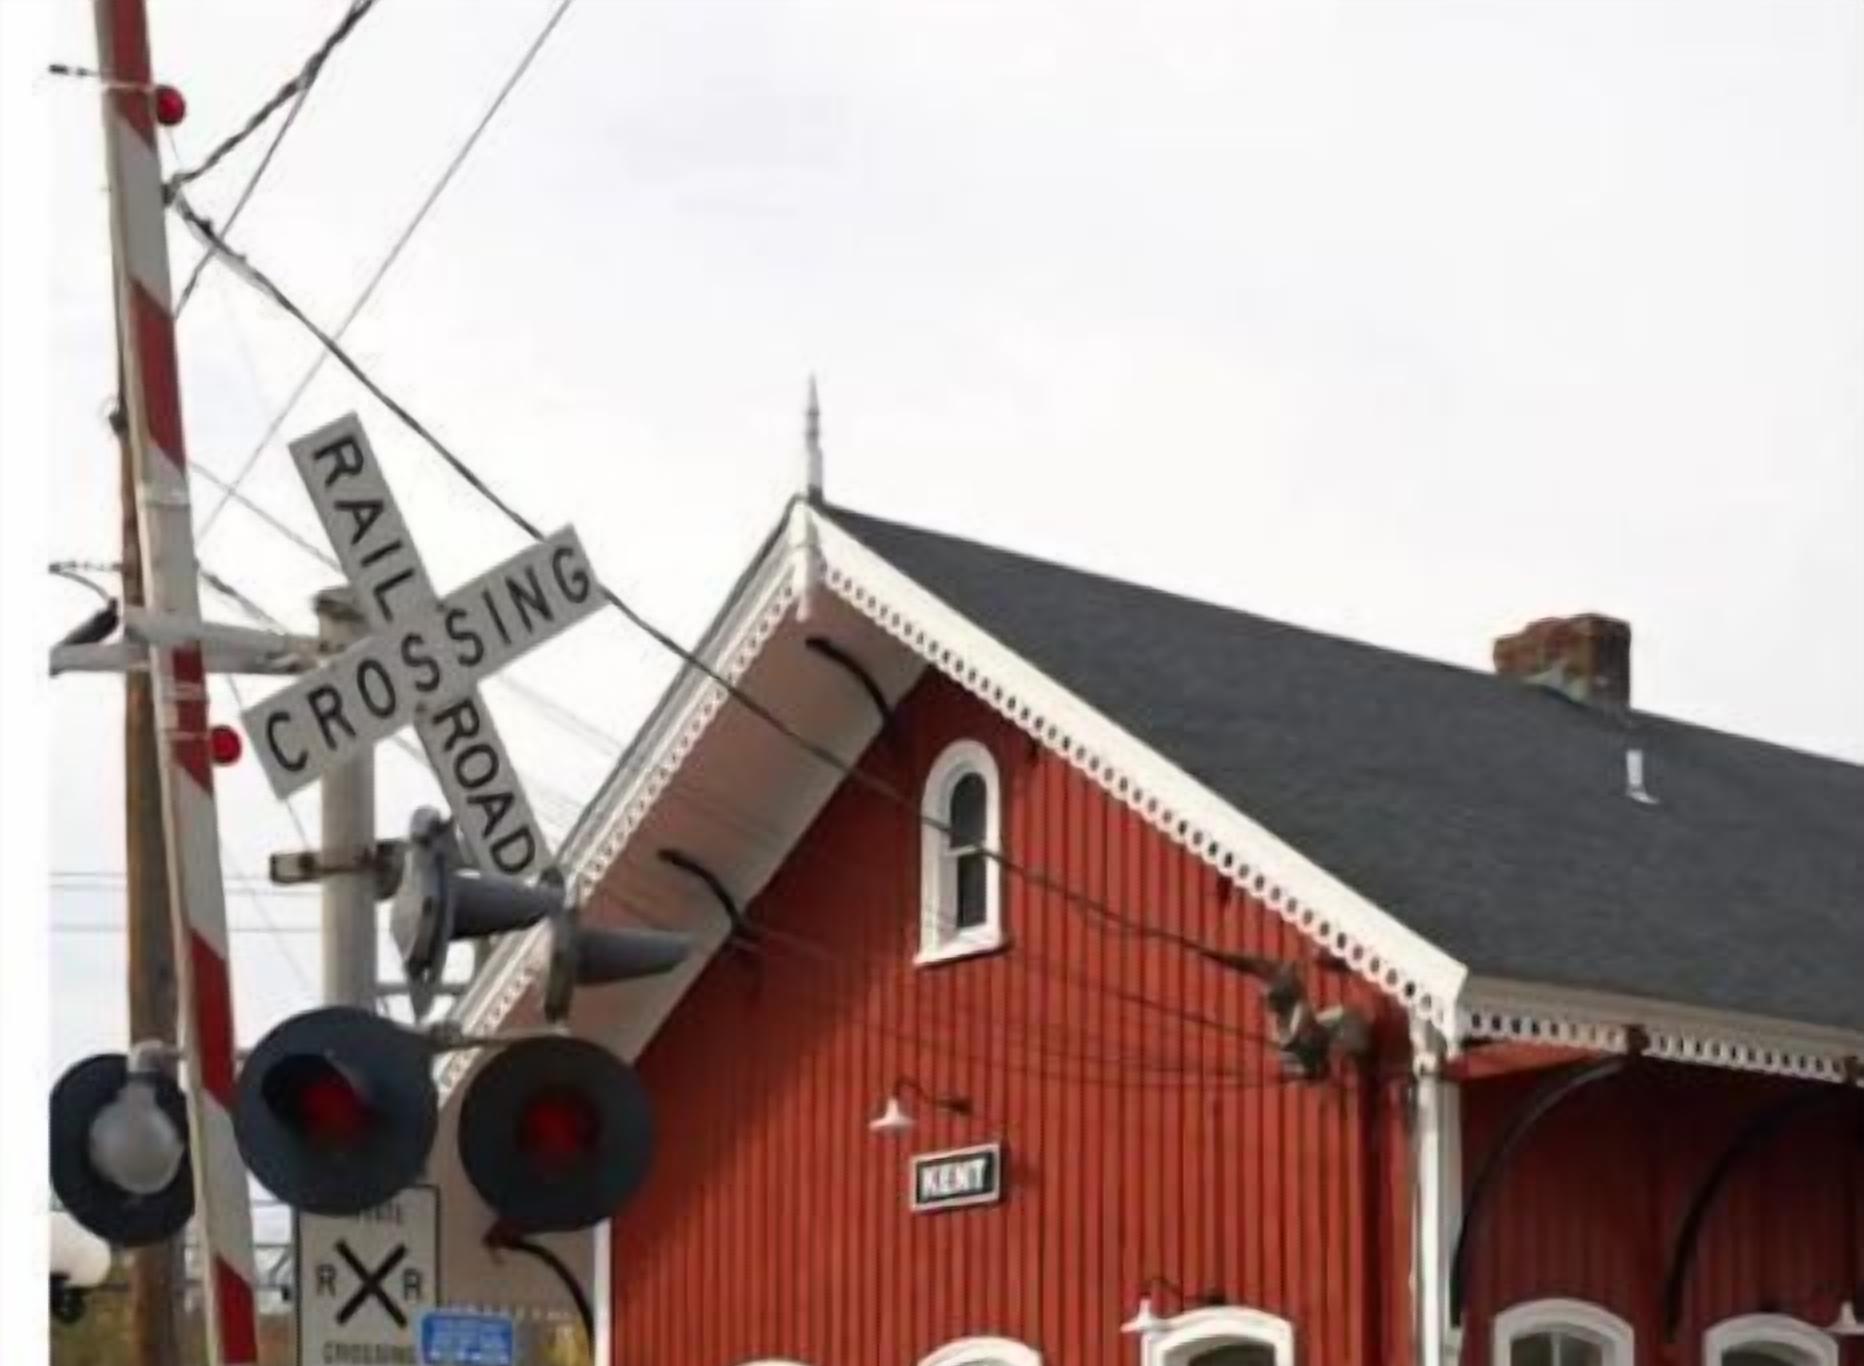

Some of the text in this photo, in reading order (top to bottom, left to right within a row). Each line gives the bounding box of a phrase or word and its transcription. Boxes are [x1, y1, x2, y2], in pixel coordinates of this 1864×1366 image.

[266, 546, 590, 773] CROSSING
[313, 434, 536, 876] RAIL ROAD
[921, 1158, 985, 1200] KENT
